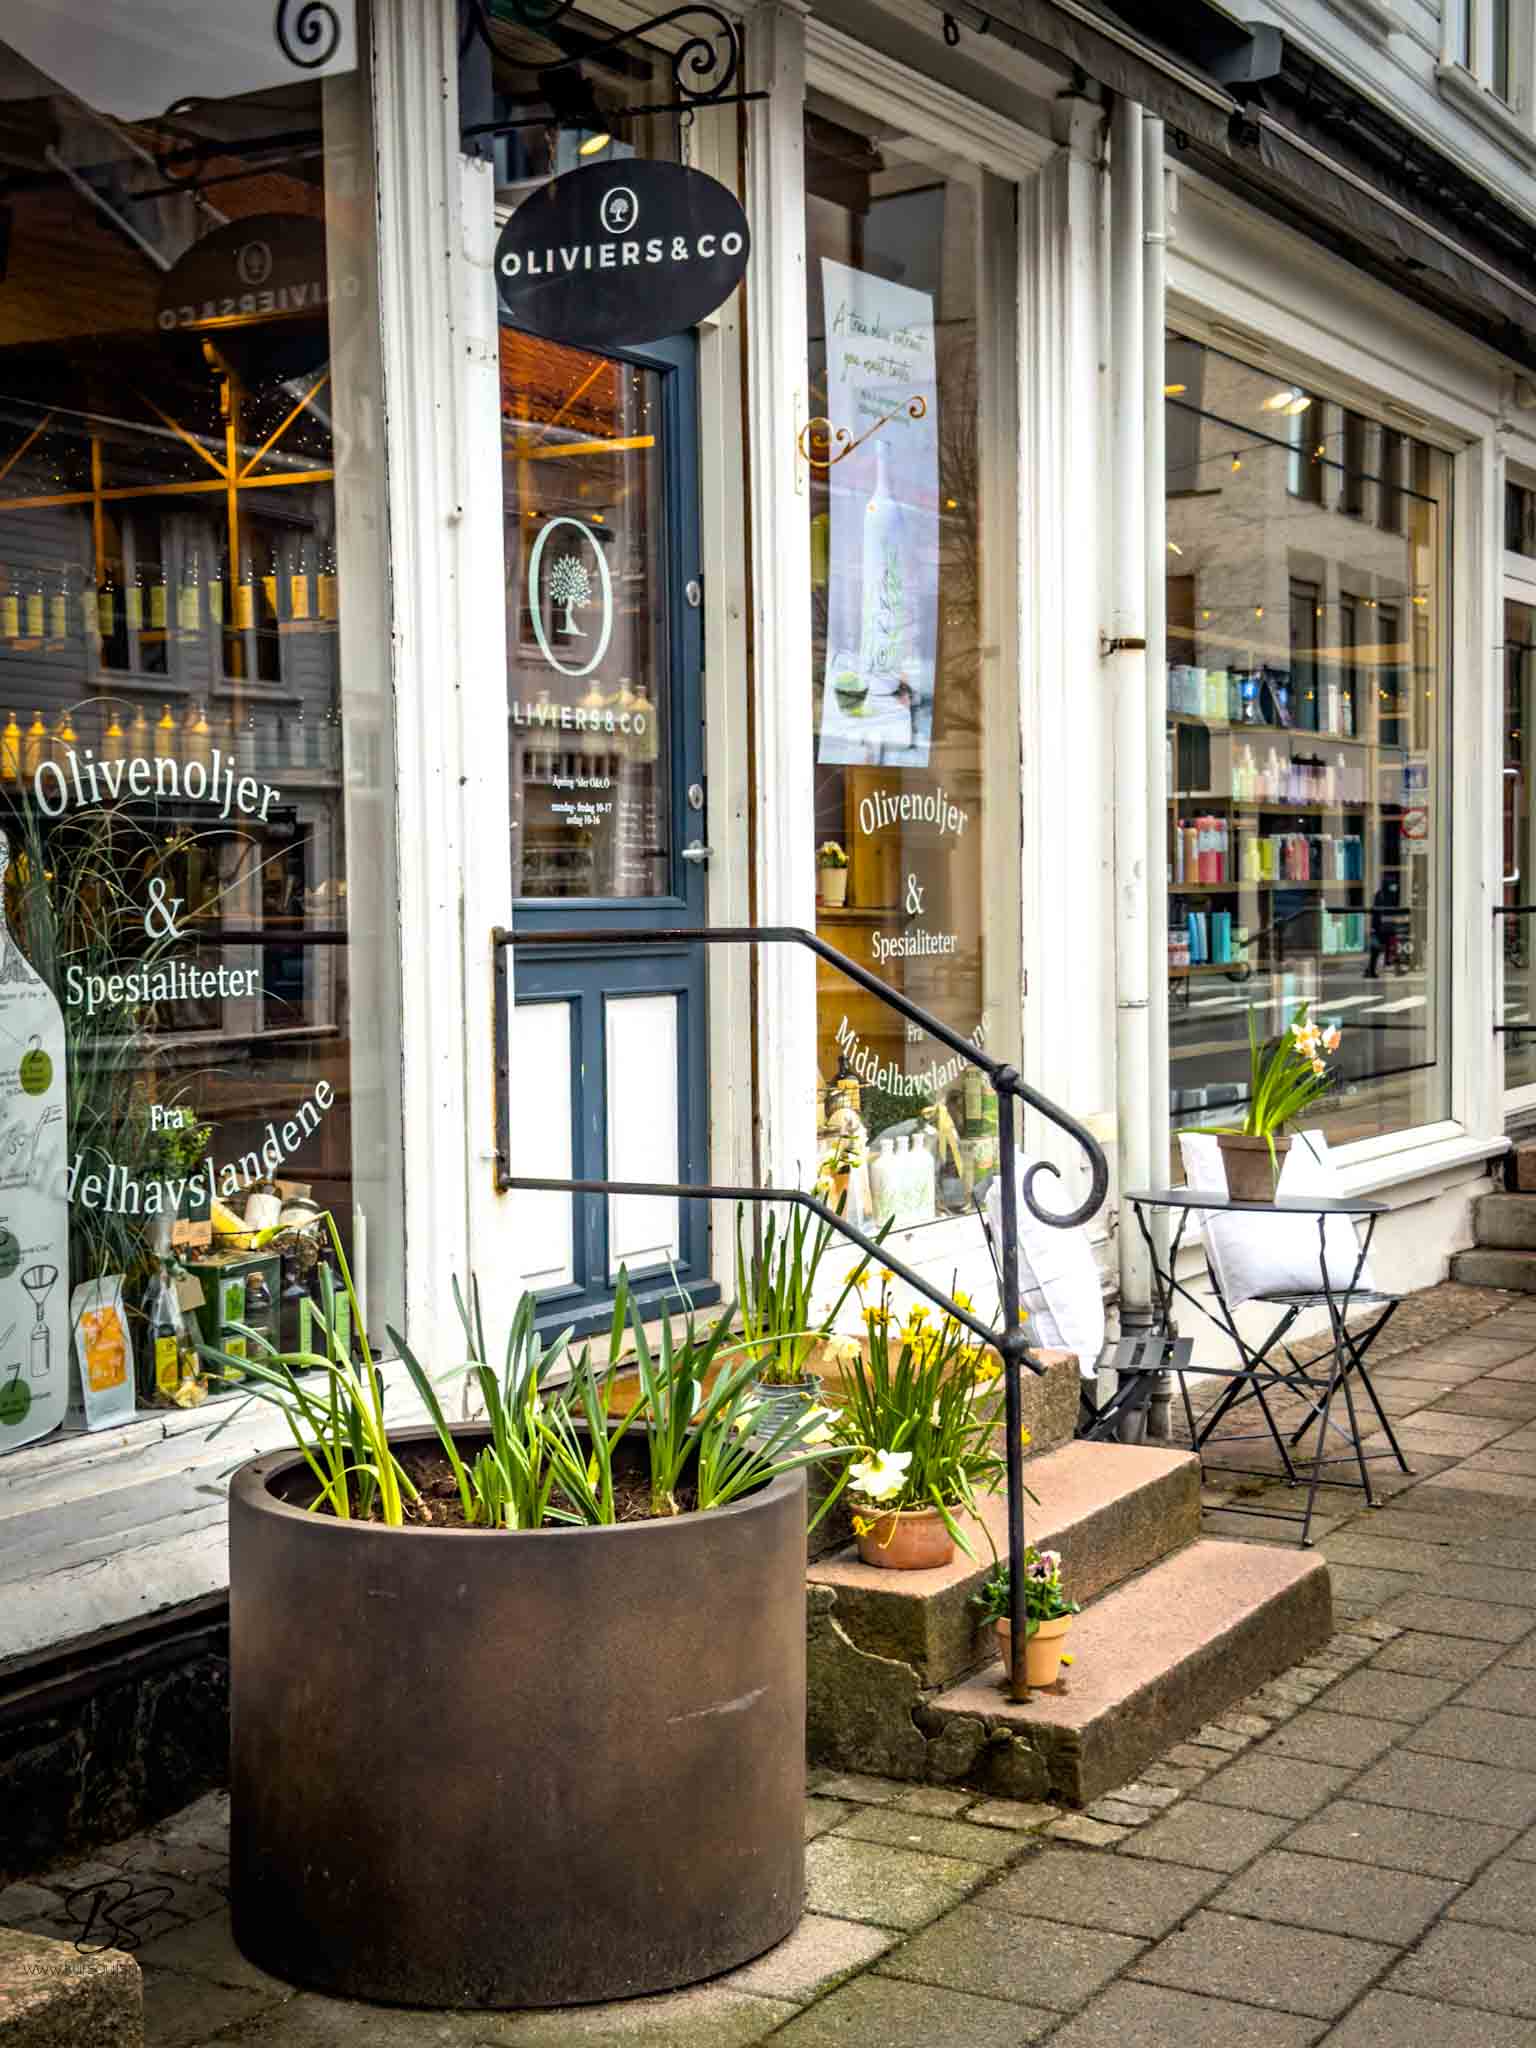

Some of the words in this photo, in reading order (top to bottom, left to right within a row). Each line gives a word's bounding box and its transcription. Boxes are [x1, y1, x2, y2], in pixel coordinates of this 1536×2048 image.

[501, 232, 742, 277] OLIVIERS&CO
[508, 701, 646, 735] LIVIERS&CO
[34, 748, 281, 823] Olivenoljer
[859, 787, 968, 835] Olivenoljer
[144, 877, 185, 940] &
[905, 873, 925, 916] &
[871, 928, 958, 965] Spesialiteter
[66, 960, 259, 1015] Spesialiteter
[835, 1015, 994, 1096] Middelhavslandne
[151, 1104, 184, 1132] Fra
